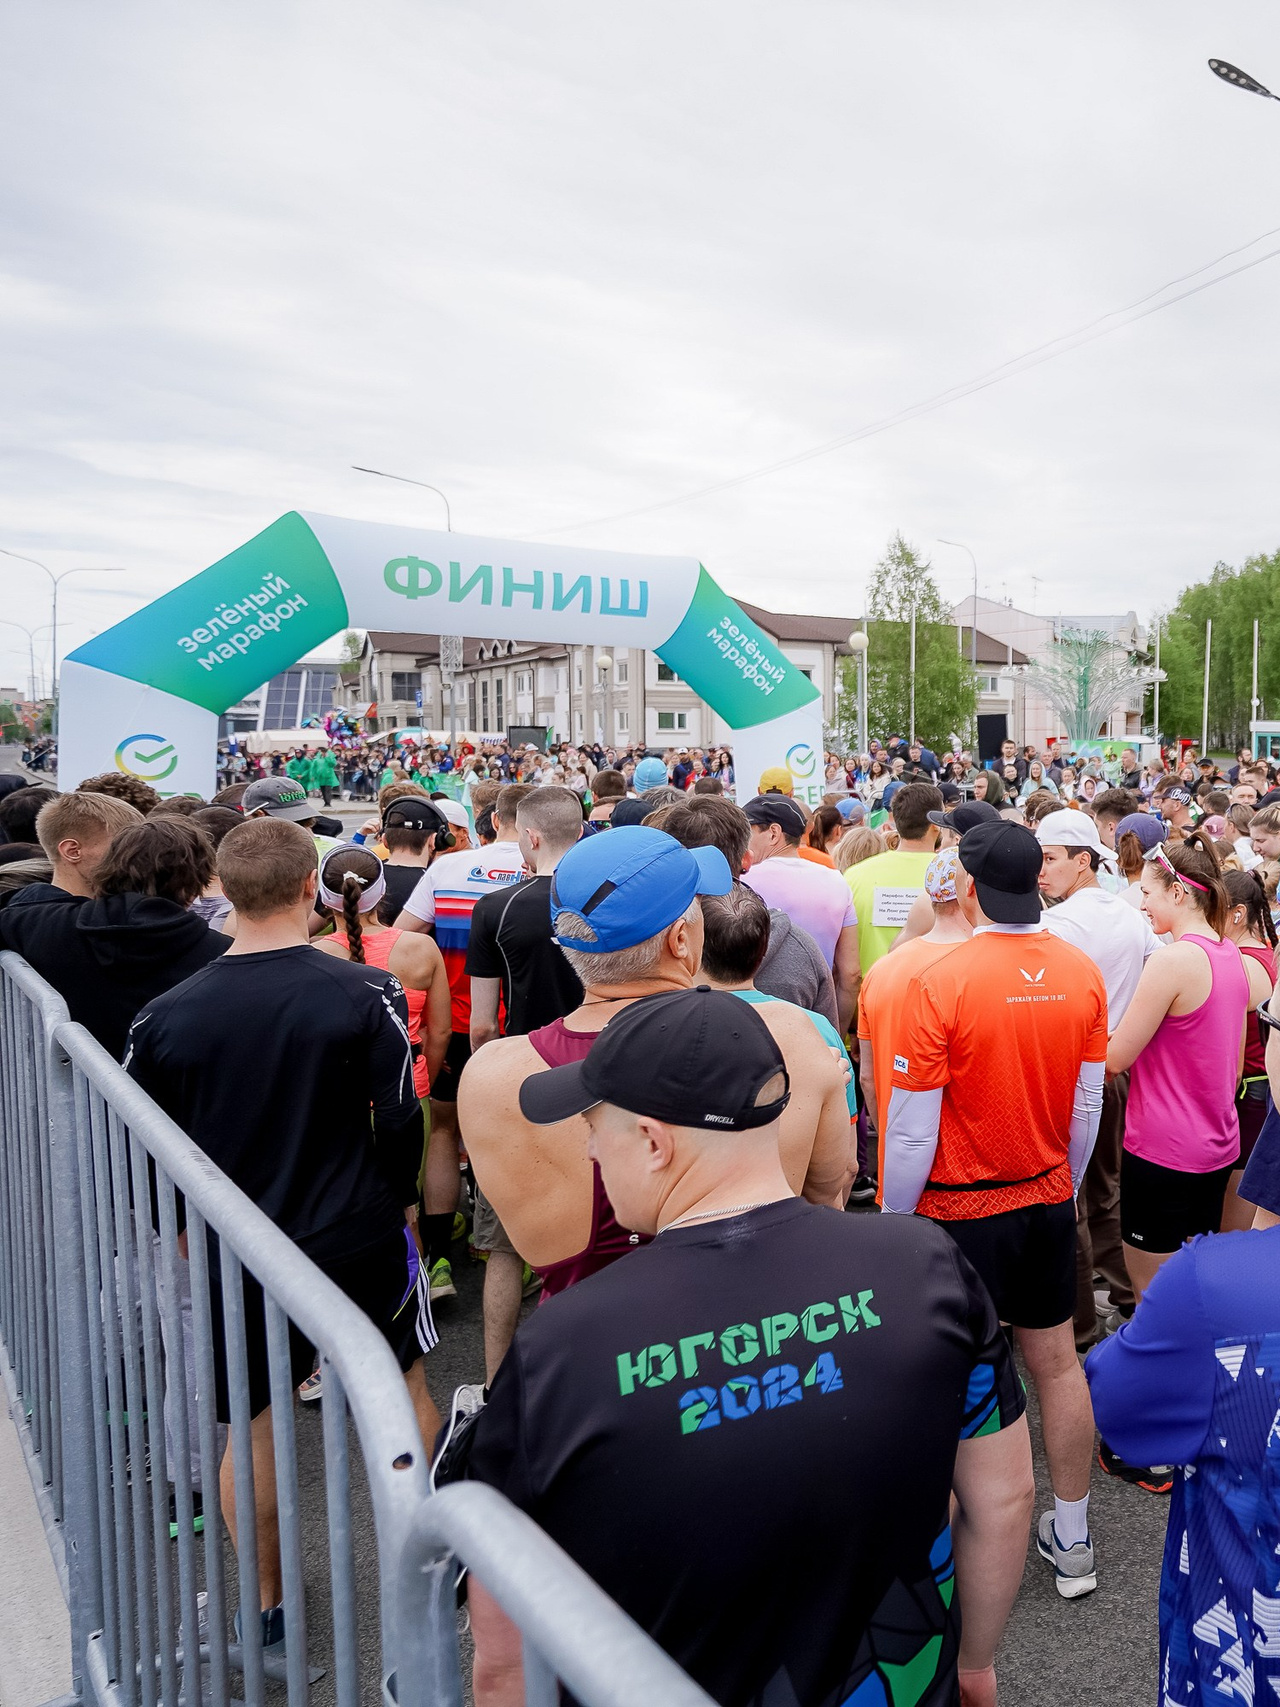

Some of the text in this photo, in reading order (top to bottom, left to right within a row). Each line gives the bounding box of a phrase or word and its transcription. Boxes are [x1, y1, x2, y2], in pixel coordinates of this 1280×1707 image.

[176, 572, 291, 654] зелёный
[383, 555, 649, 618] ФИНИШ
[197, 593, 309, 672] марафон
[706, 627, 775, 696] марафон
[720, 616, 786, 684] зелёный
[704, 1113, 735, 1125] DRYCELL
[616, 1288, 882, 1397] ЮГОРСК
[678, 1351, 845, 1436] 2024
